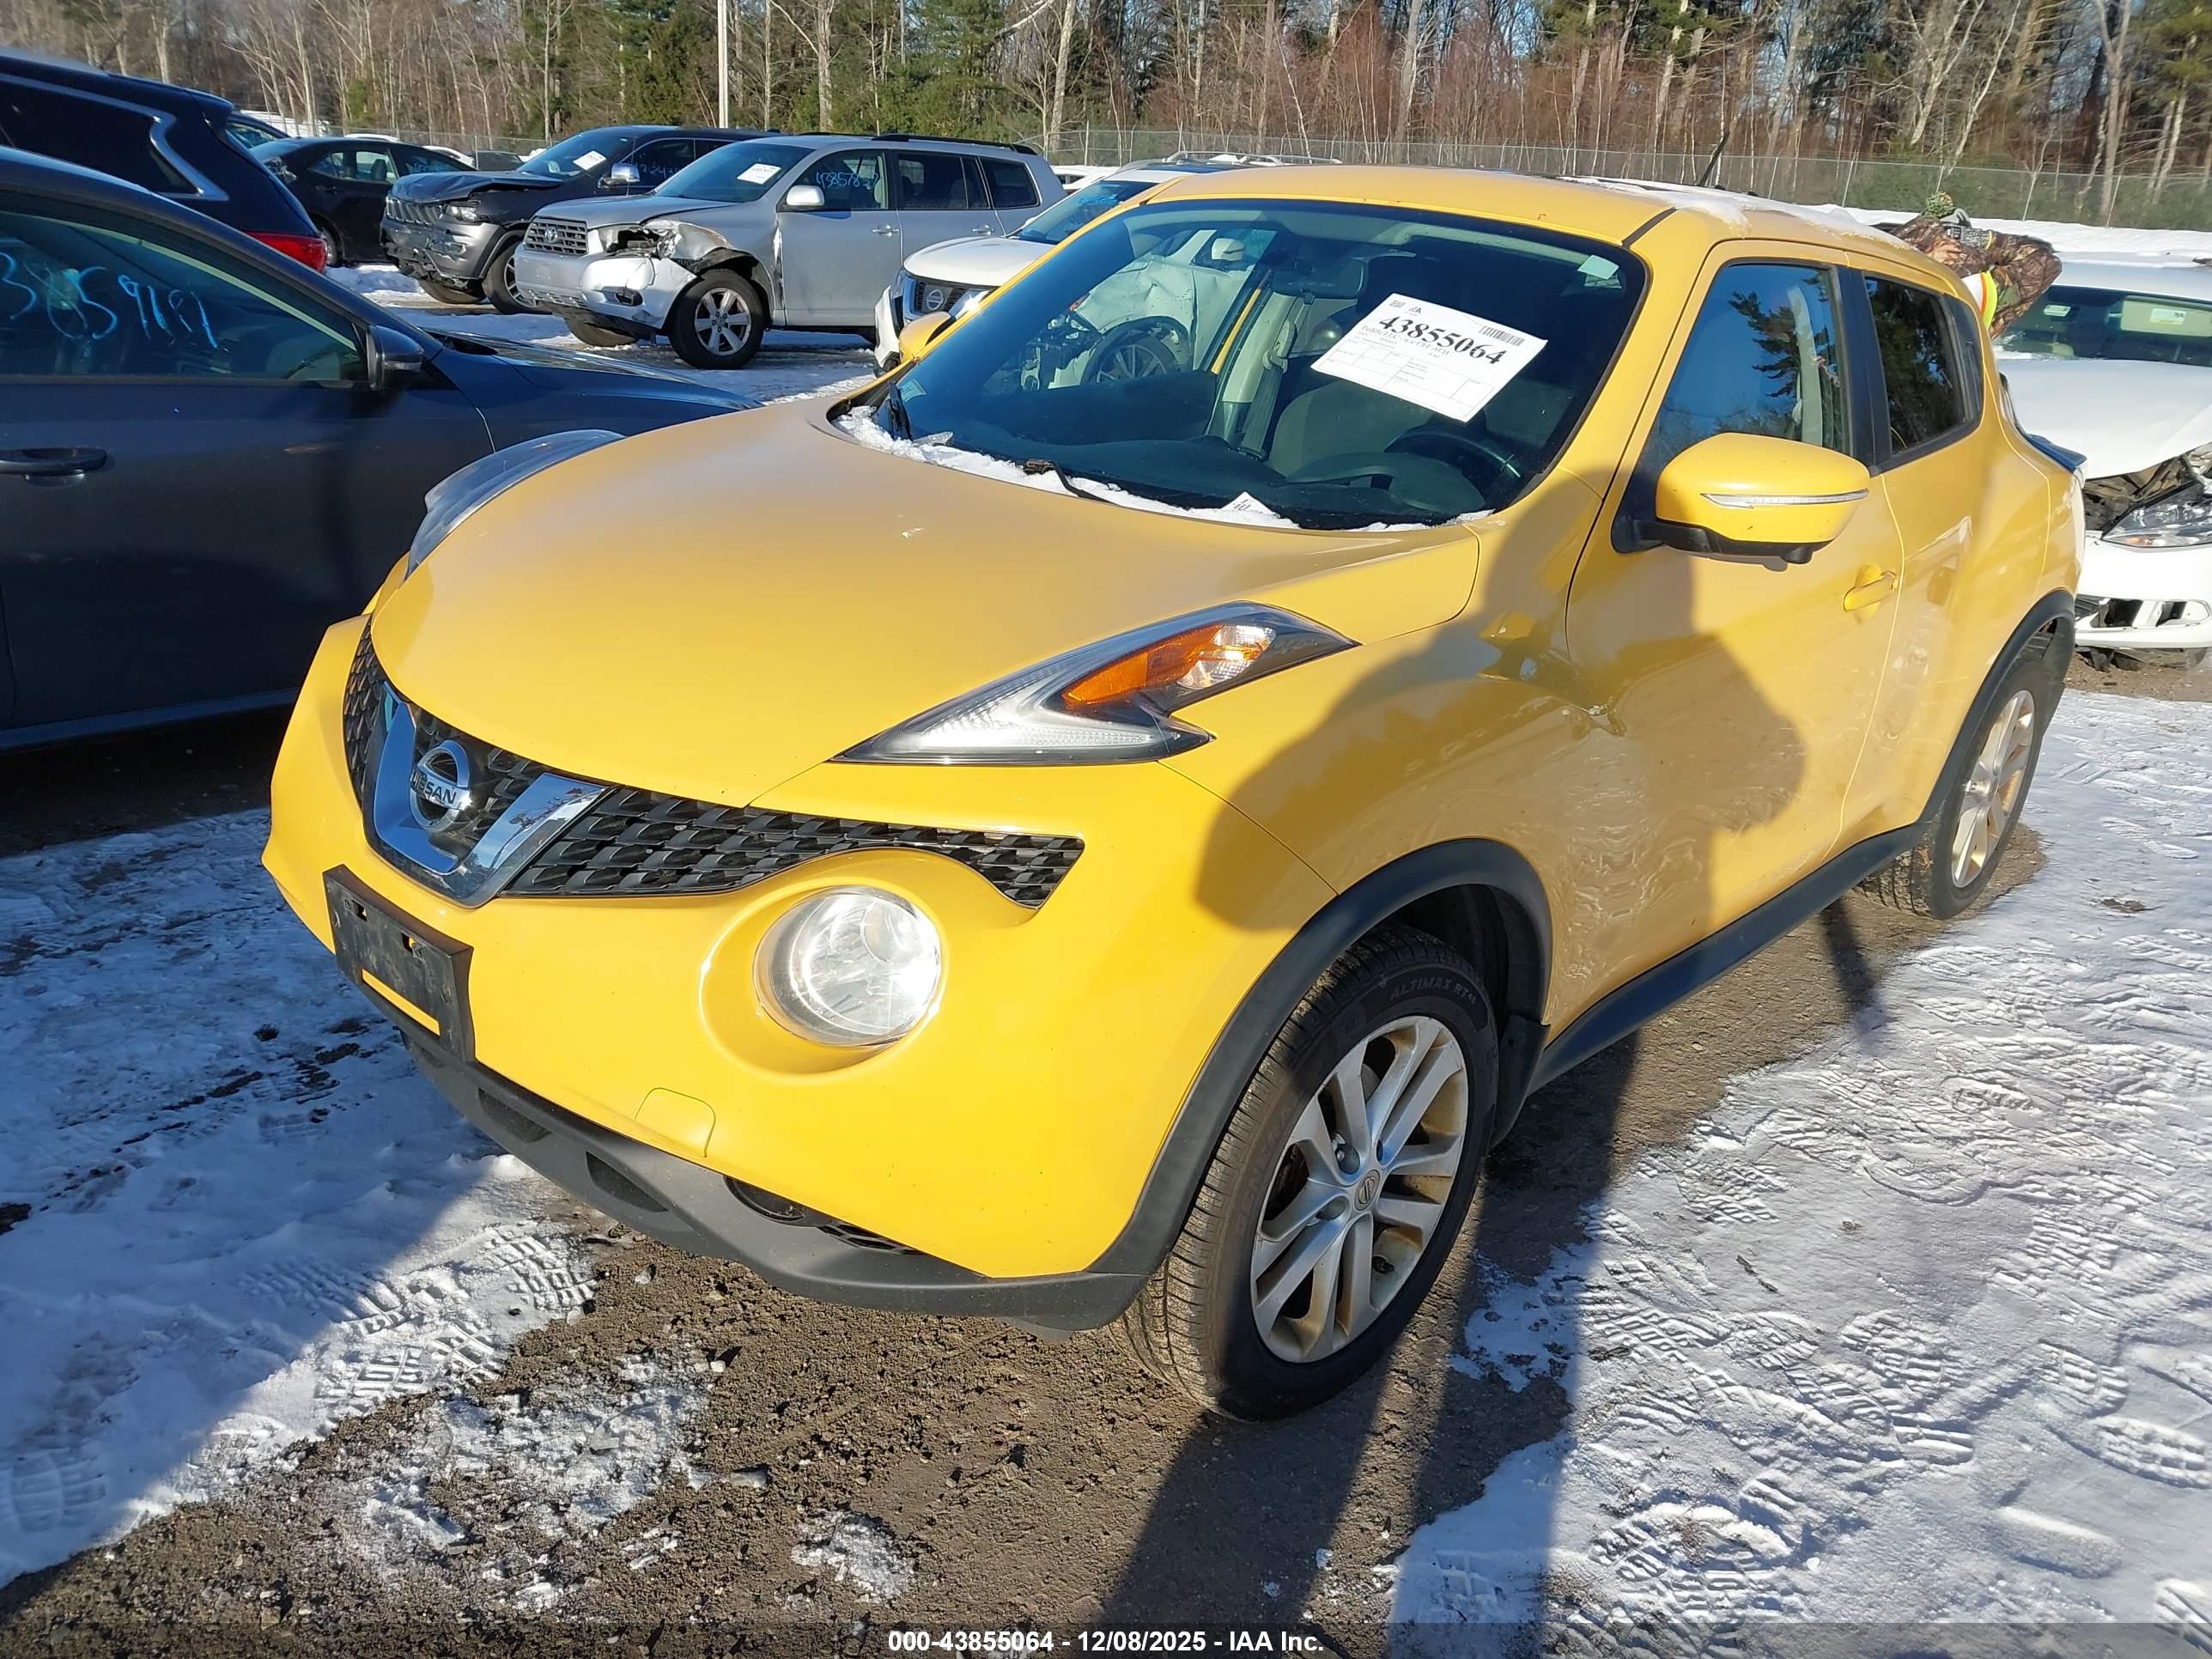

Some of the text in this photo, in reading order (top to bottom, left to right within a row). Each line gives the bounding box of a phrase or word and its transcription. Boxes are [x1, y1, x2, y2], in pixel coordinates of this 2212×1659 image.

[1378, 316, 1507, 365] 43855064
[410, 769, 457, 805] NISSAN
[1389, 976, 1453, 1001] ALTIMAX
